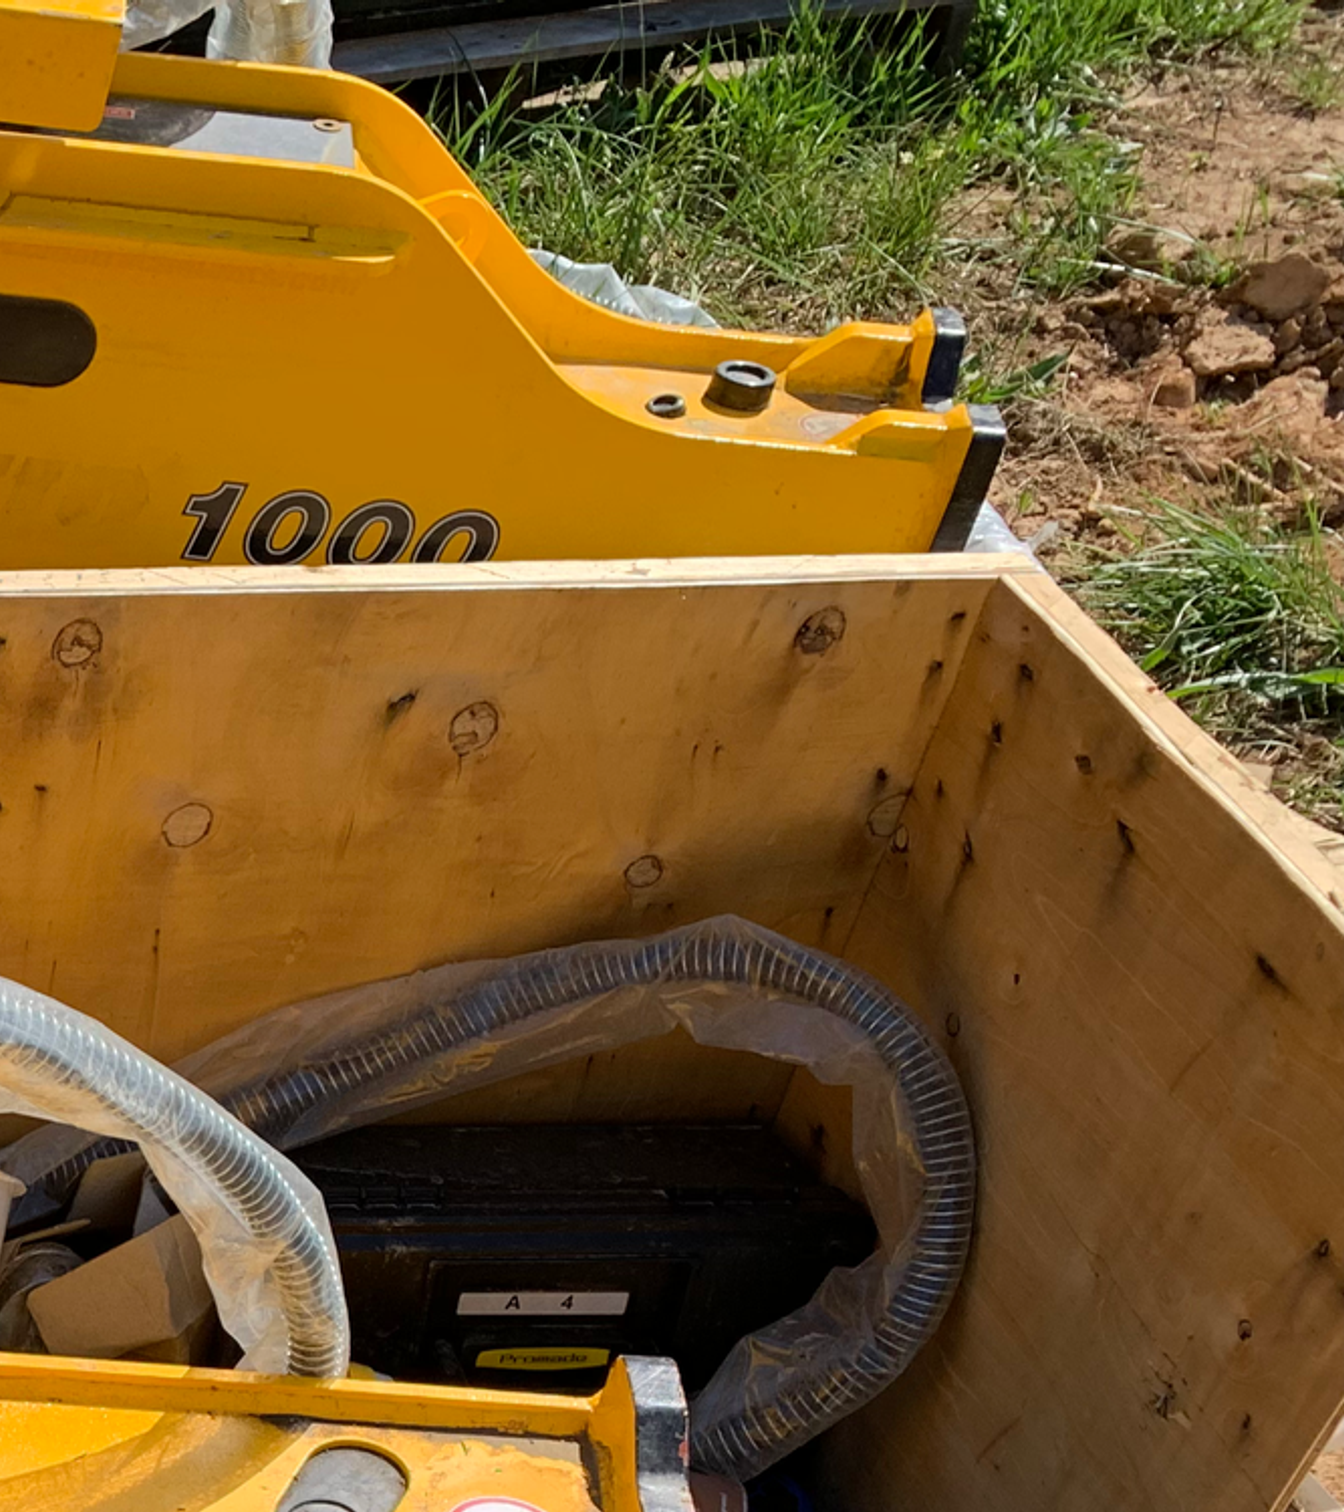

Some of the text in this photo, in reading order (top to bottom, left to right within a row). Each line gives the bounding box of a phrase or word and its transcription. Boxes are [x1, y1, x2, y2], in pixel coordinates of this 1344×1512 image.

[180, 481, 501, 566] 1000
[505, 1295, 574, 1310] A 4
